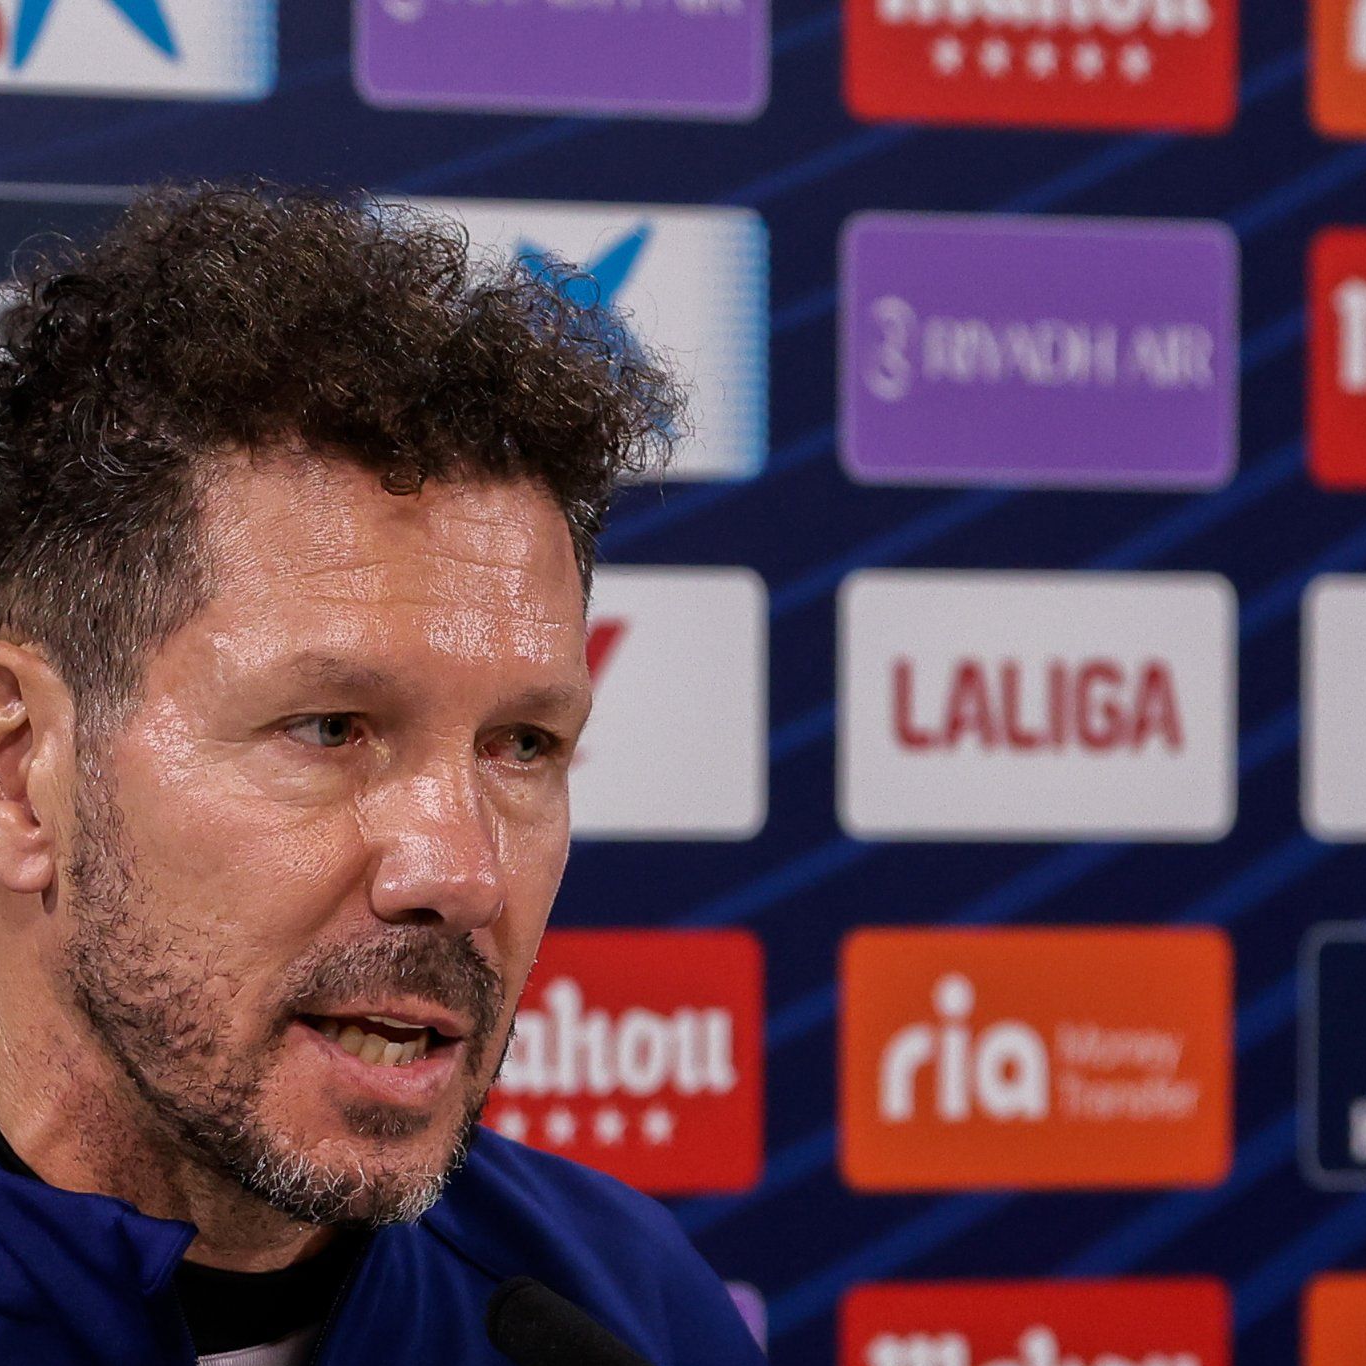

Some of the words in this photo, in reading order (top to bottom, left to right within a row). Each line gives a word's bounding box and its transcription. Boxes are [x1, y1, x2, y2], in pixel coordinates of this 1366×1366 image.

[892, 659, 1184, 754] LALIGA
[499, 979, 735, 1095] ahou
[881, 976, 1048, 1120] ria
